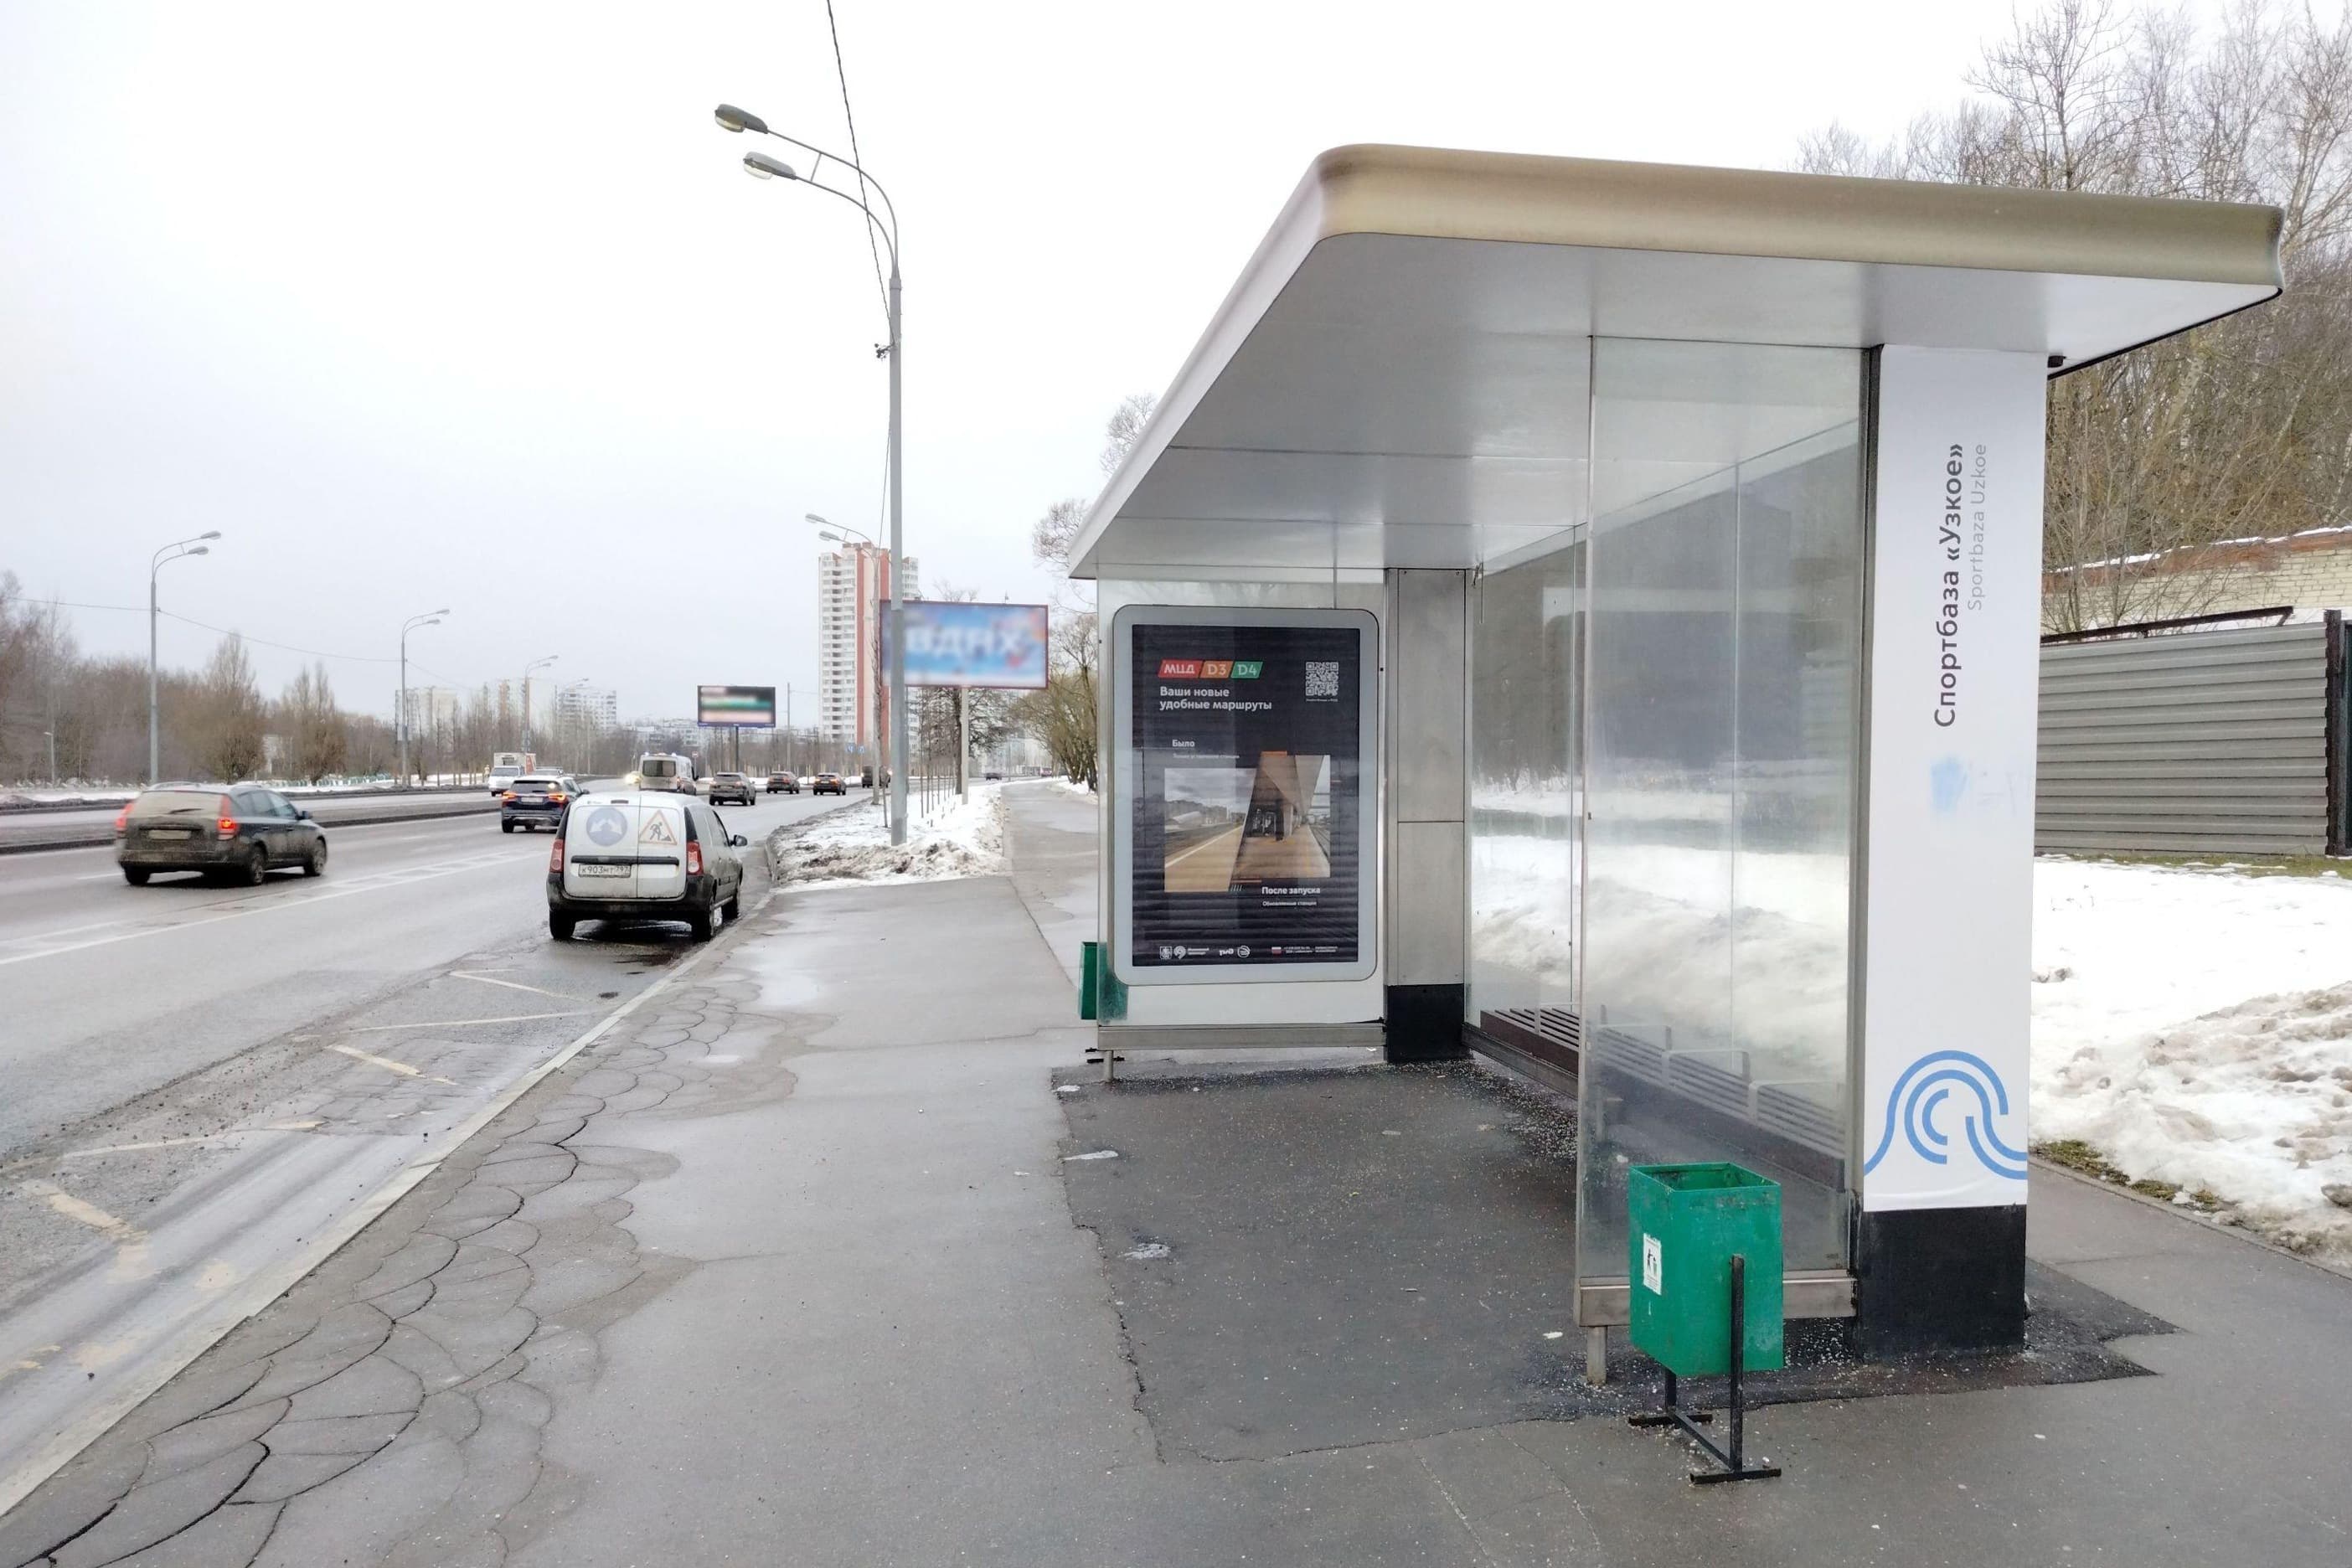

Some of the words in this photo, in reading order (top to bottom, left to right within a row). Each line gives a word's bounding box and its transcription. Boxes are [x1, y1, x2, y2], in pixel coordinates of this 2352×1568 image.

[1970, 444, 1987, 504] Uzkoe
[1939, 443, 1963, 561] «Узкое»
[1968, 511, 1986, 611] Sportbaza
[1934, 571, 1962, 727] Спортбаза
[1163, 663, 1196, 675] МЦД
[1207, 664, 1227, 675] D3
[1238, 664, 1258, 676] D4
[1159, 686, 1191, 697] Ваши
[1194, 688, 1230, 698] новые
[1159, 699, 1210, 711] удобные
[1213, 702, 1272, 712] маршруты
[1172, 739, 1195, 748] Было
[1261, 886, 1287, 895] После
[1288, 887, 1321, 895] запуска
